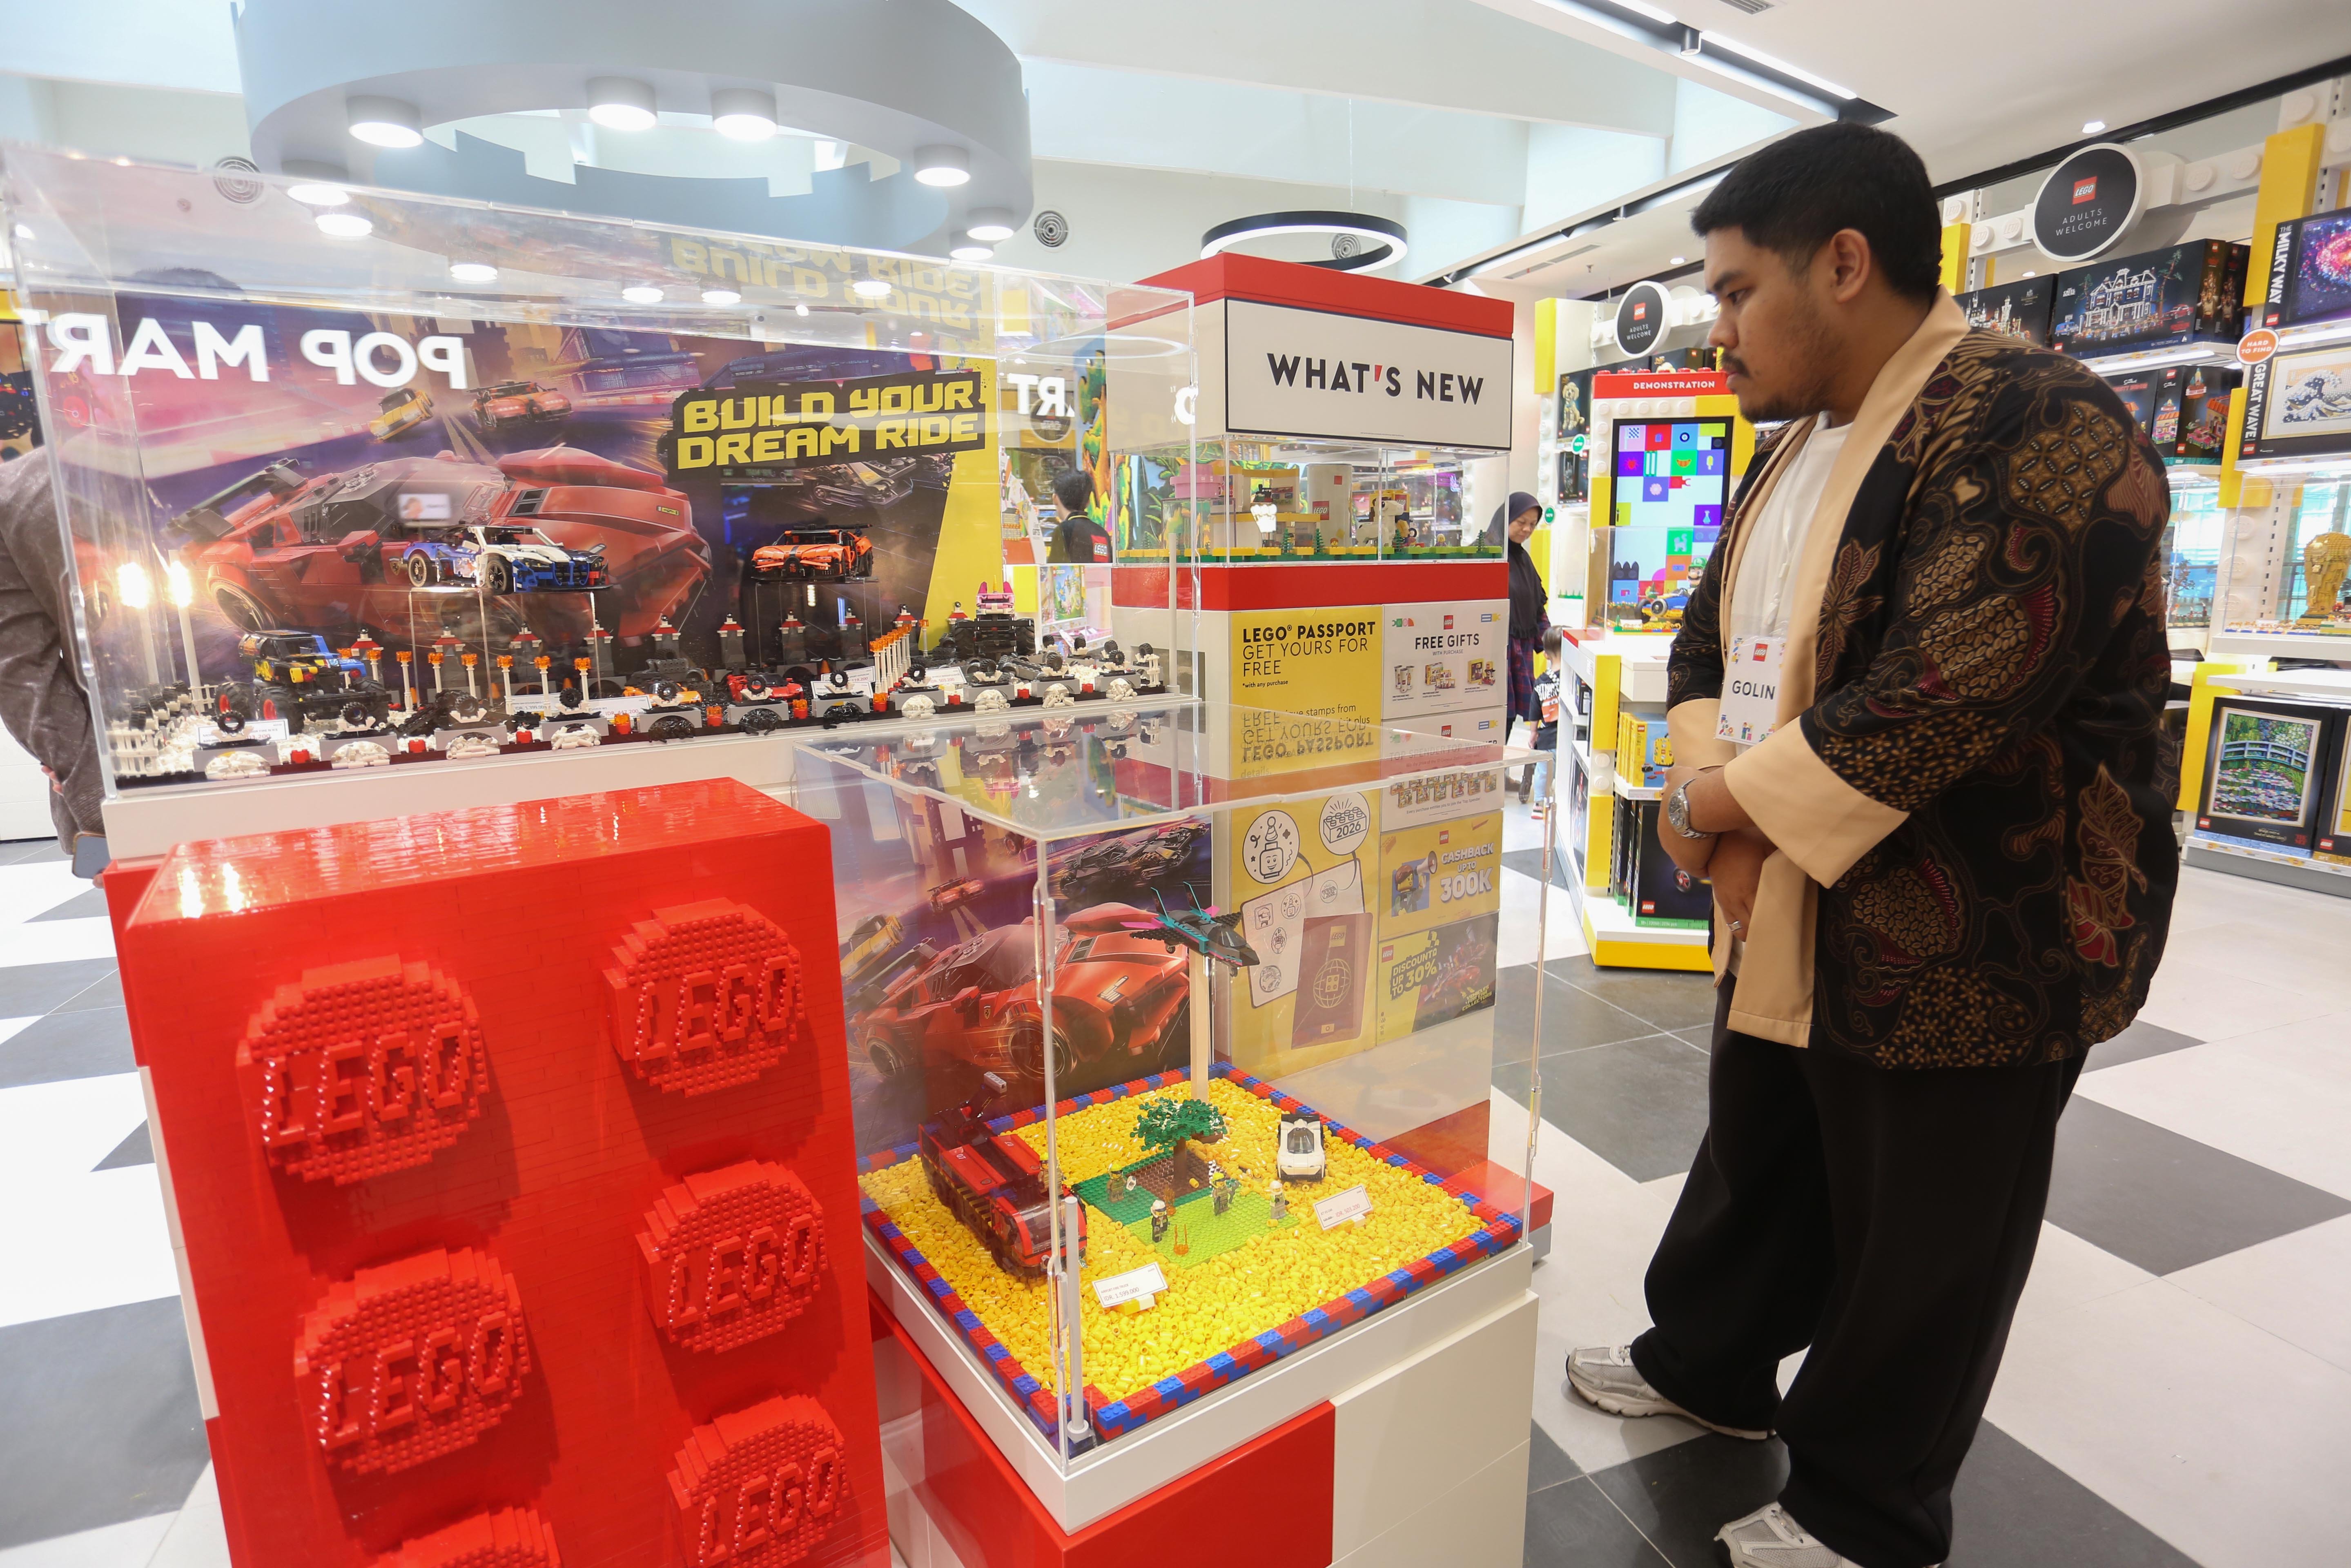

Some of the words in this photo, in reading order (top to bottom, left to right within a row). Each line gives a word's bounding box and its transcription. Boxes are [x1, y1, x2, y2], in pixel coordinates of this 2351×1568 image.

[2074, 183, 2094, 198] LEGO
[2056, 217, 2107, 236] WELCOME
[2062, 209, 2102, 224] ADULTS
[2273, 232, 2292, 272] MILKY
[2269, 274, 2284, 304] WAY
[1627, 330, 1651, 340] WELCOME
[1629, 324, 1649, 333] ADULTS
[1267, 353, 1401, 396] WHAT'S
[1417, 370, 1484, 405] NEW
[1633, 381, 1715, 390] DEMONSTRATION
[2251, 363, 2266, 402] GREAT
[684, 392, 834, 433] BUILD
[849, 381, 973, 417] YOUR
[2244, 404, 2261, 438] WAVE
[678, 424, 860, 469] DREAM
[875, 413, 978, 450] RIDE
[1094, 544, 1108, 555] LEGO
[1298, 621, 1375, 639] PASSPORT
[1243, 644, 1275, 660] GET
[1281, 640, 1332, 657] YOURS
[1339, 638, 1368, 653] FOR
[1415, 636, 1443, 650] FREE
[1447, 633, 1479, 647] GIFTS
[1243, 660, 1281, 677] FREE
[1732, 680, 1775, 700] GOLIN
[1306, 708, 1335, 717] stamps
[1337, 704, 1356, 713] from
[1336, 821, 1361, 838] 2026
[1441, 842, 1494, 864] CASHBACK
[1457, 864, 1466, 873] UP
[1467, 861, 1476, 870] TO
[1440, 868, 1493, 902] 300K
[1392, 984, 1403, 996] TO
[1405, 958, 1437, 988] 30%
[1393, 975, 1404, 987] UP
[1462, 991, 1492, 1011] COLLECTORS
[1466, 984, 1489, 1000] VEHICLES
[635, 956, 795, 1061] LEGO
[264, 1022, 471, 1146] LEGO
[1344, 1203, 1360, 1214] 503.200
[667, 1214, 816, 1329] LEGO
[1116, 1287, 1139, 1298] 1.599.000
[319, 1311, 514, 1450] LEGO
[699, 1448, 841, 1568] LEGO
